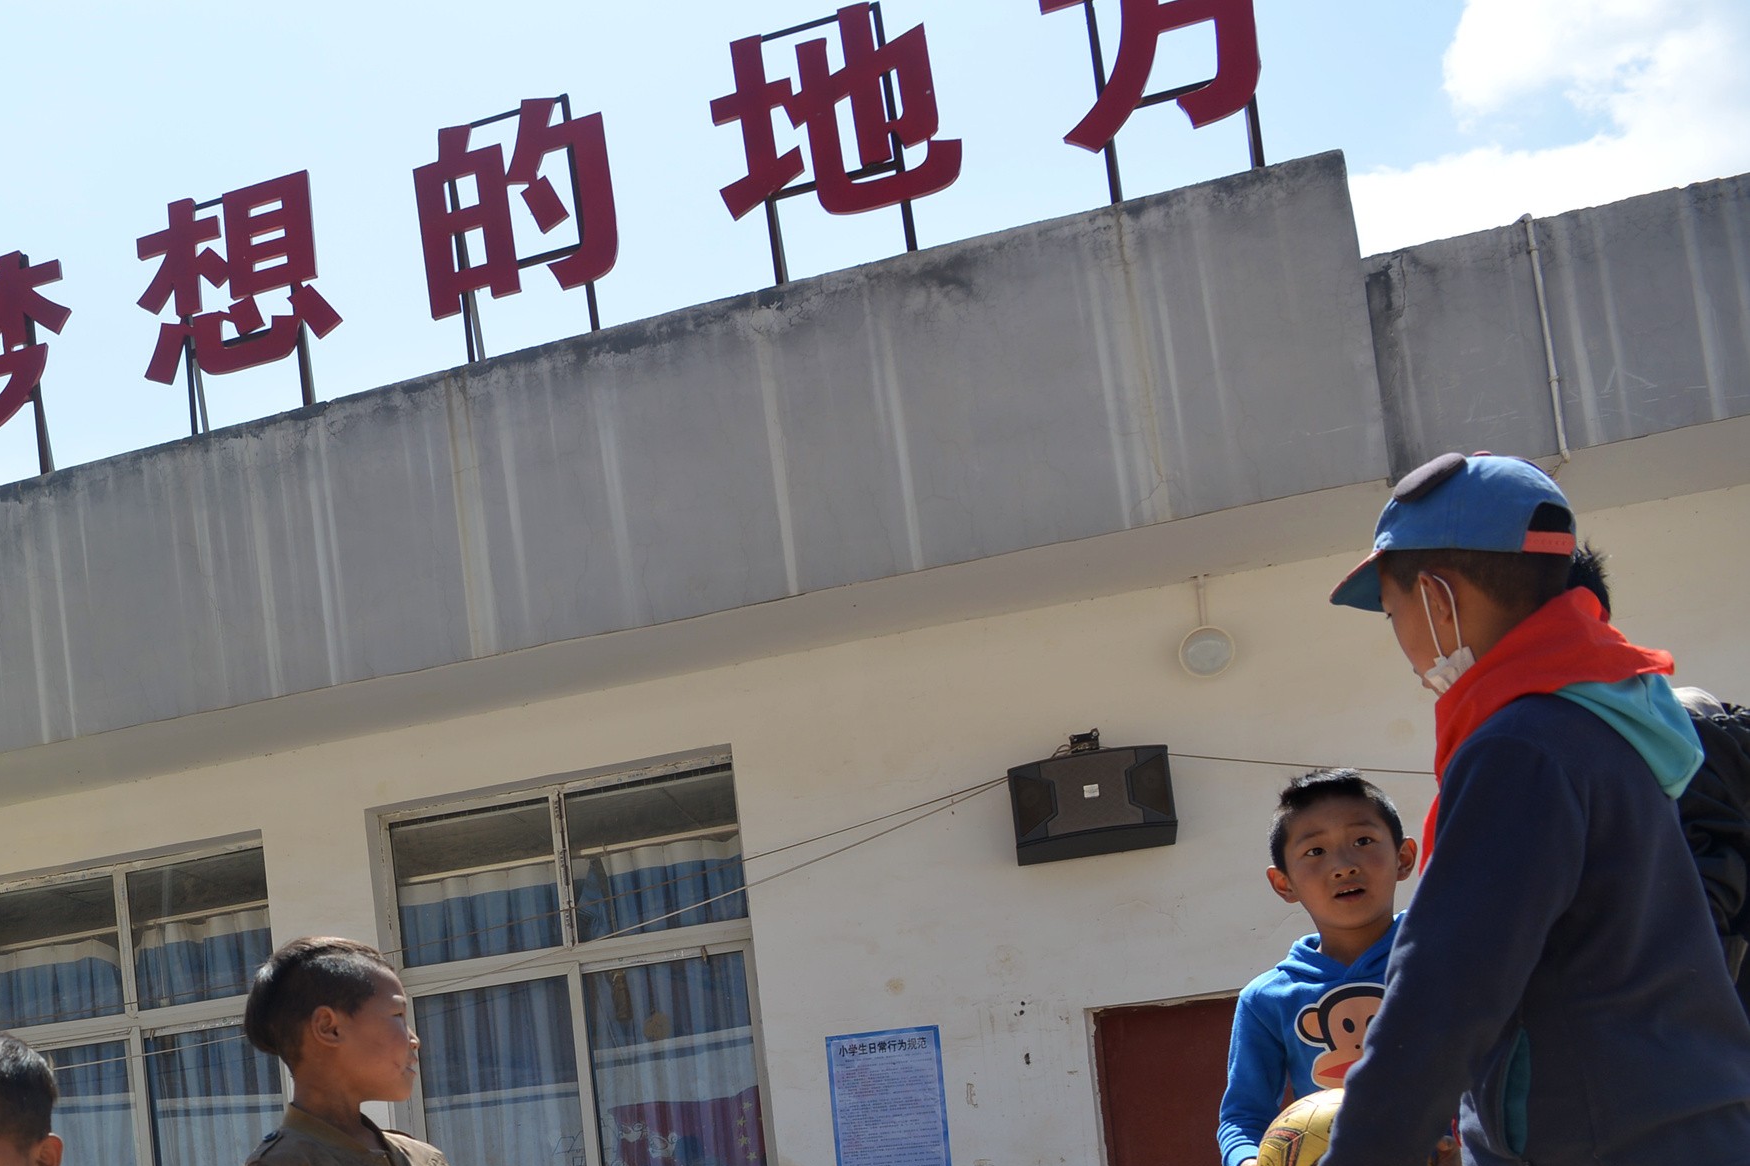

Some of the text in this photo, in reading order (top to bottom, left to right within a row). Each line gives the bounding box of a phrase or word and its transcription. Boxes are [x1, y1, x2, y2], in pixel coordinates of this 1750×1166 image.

[838, 1036, 928, 1058] 小学生日常行为规范
